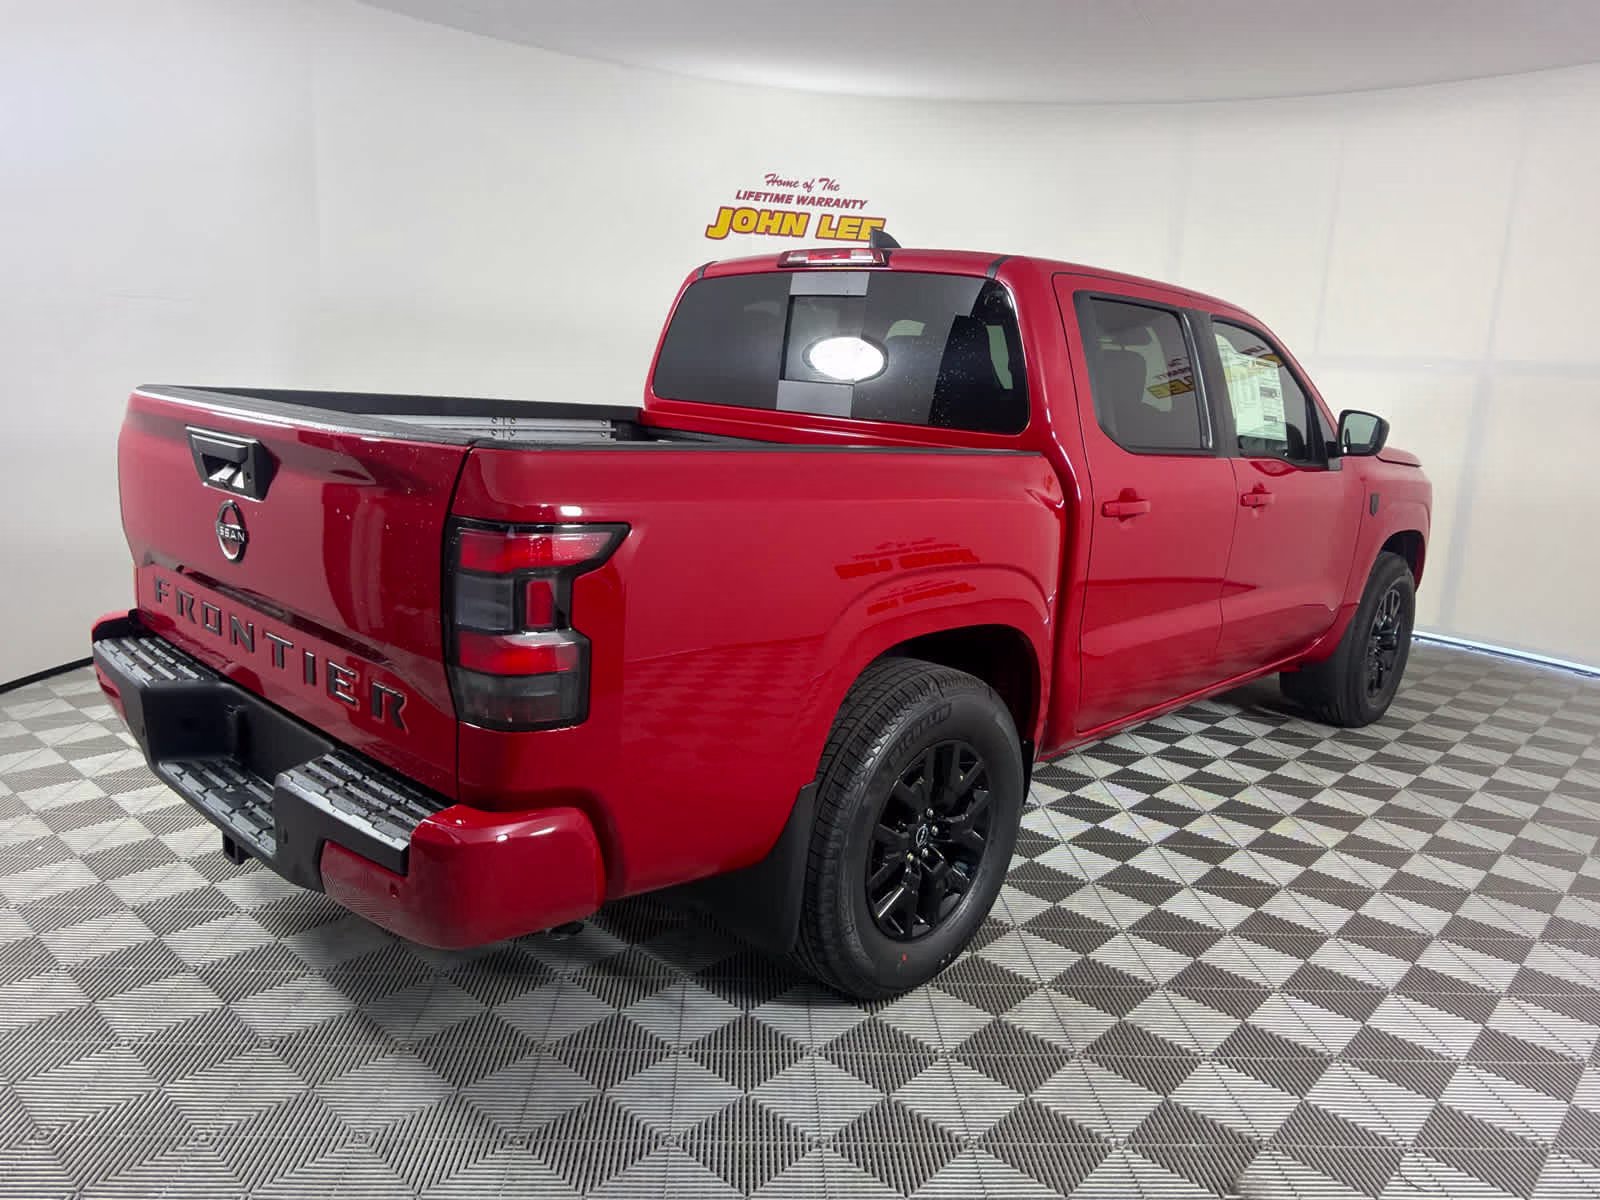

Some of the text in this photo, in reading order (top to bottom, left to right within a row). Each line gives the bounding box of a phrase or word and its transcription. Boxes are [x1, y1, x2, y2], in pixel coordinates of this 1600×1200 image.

[764, 173, 840, 192] Home of The
[735, 190, 868, 209] LIFETIME WARRANTY
[705, 206, 811, 240] JOHN
[154, 577, 406, 731] FRONTIER
